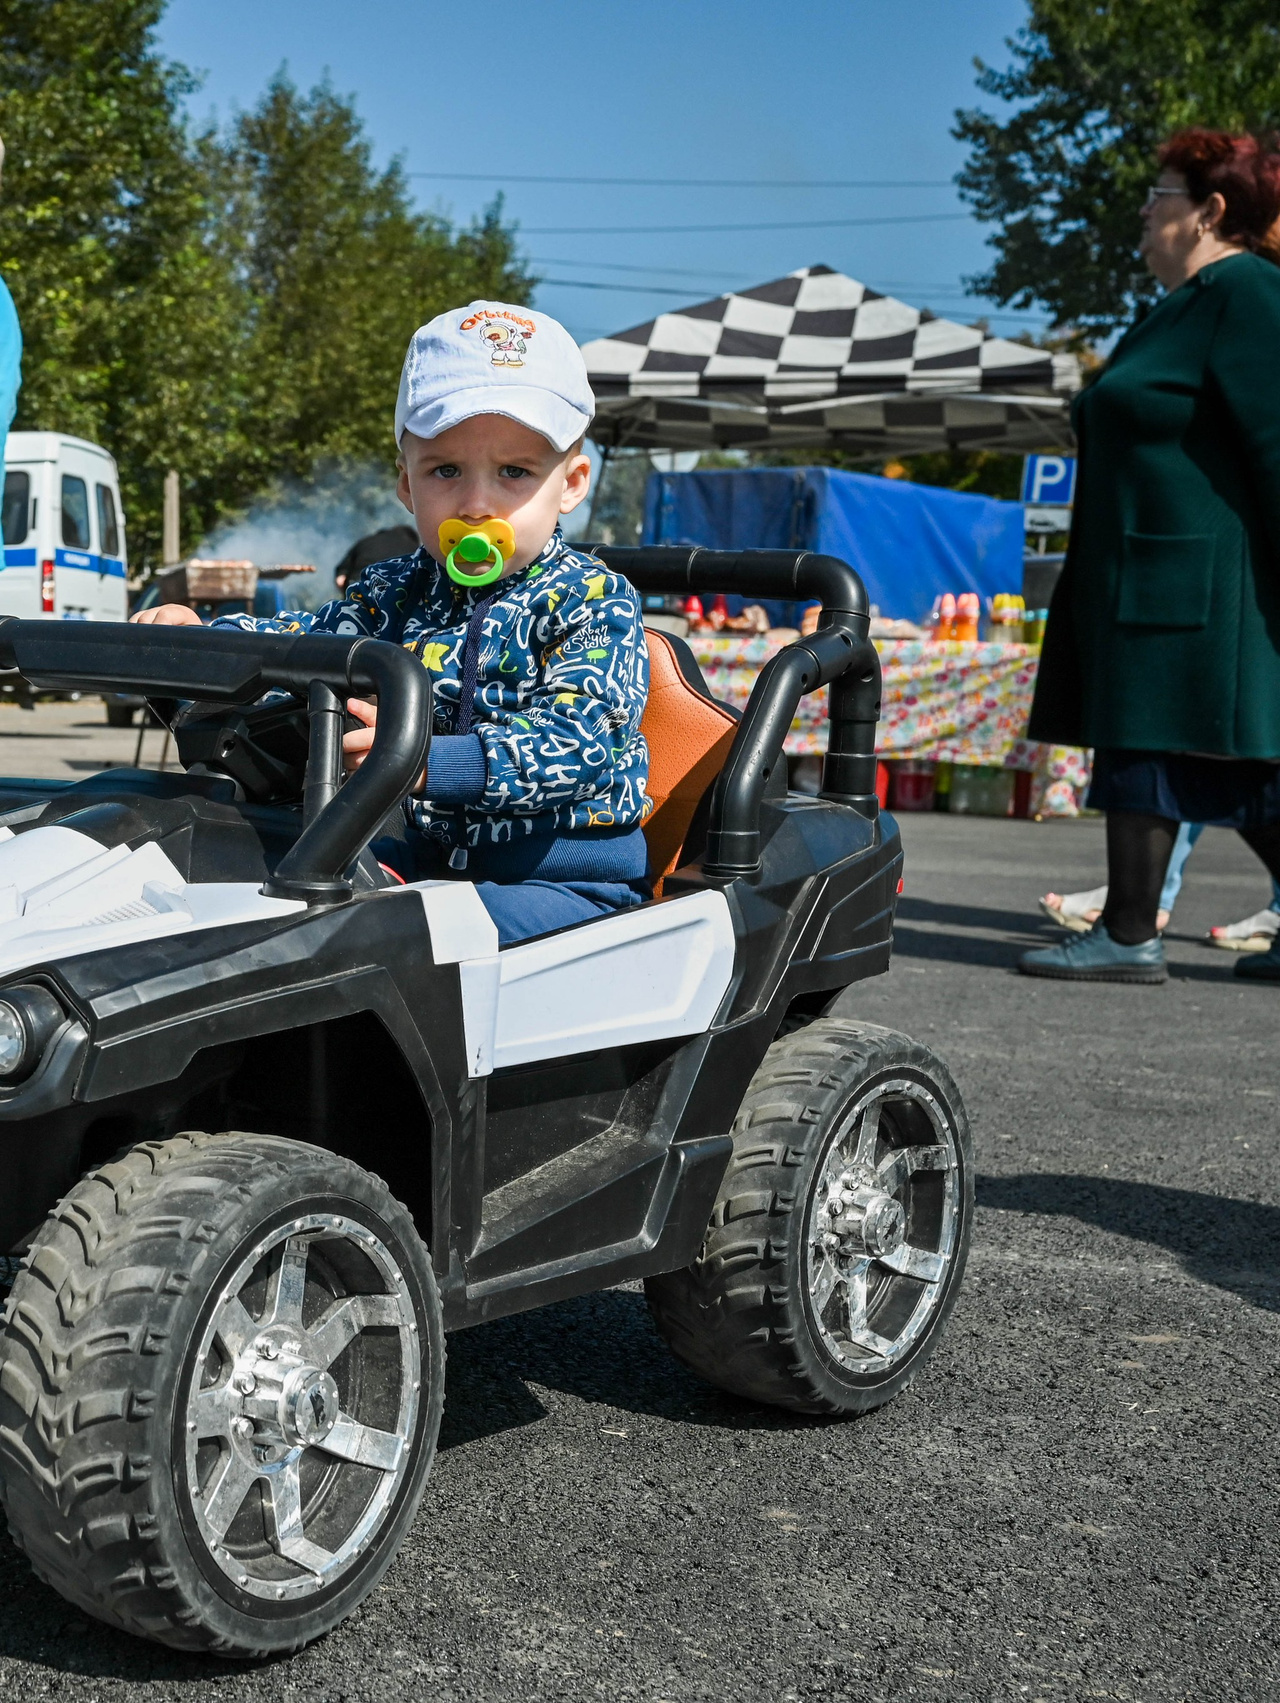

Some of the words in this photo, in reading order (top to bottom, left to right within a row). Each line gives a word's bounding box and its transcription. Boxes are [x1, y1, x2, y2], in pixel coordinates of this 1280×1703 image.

[460, 310, 536, 332] Orbiting
[1032, 455, 1066, 503] P
[563, 633, 613, 654] Style
